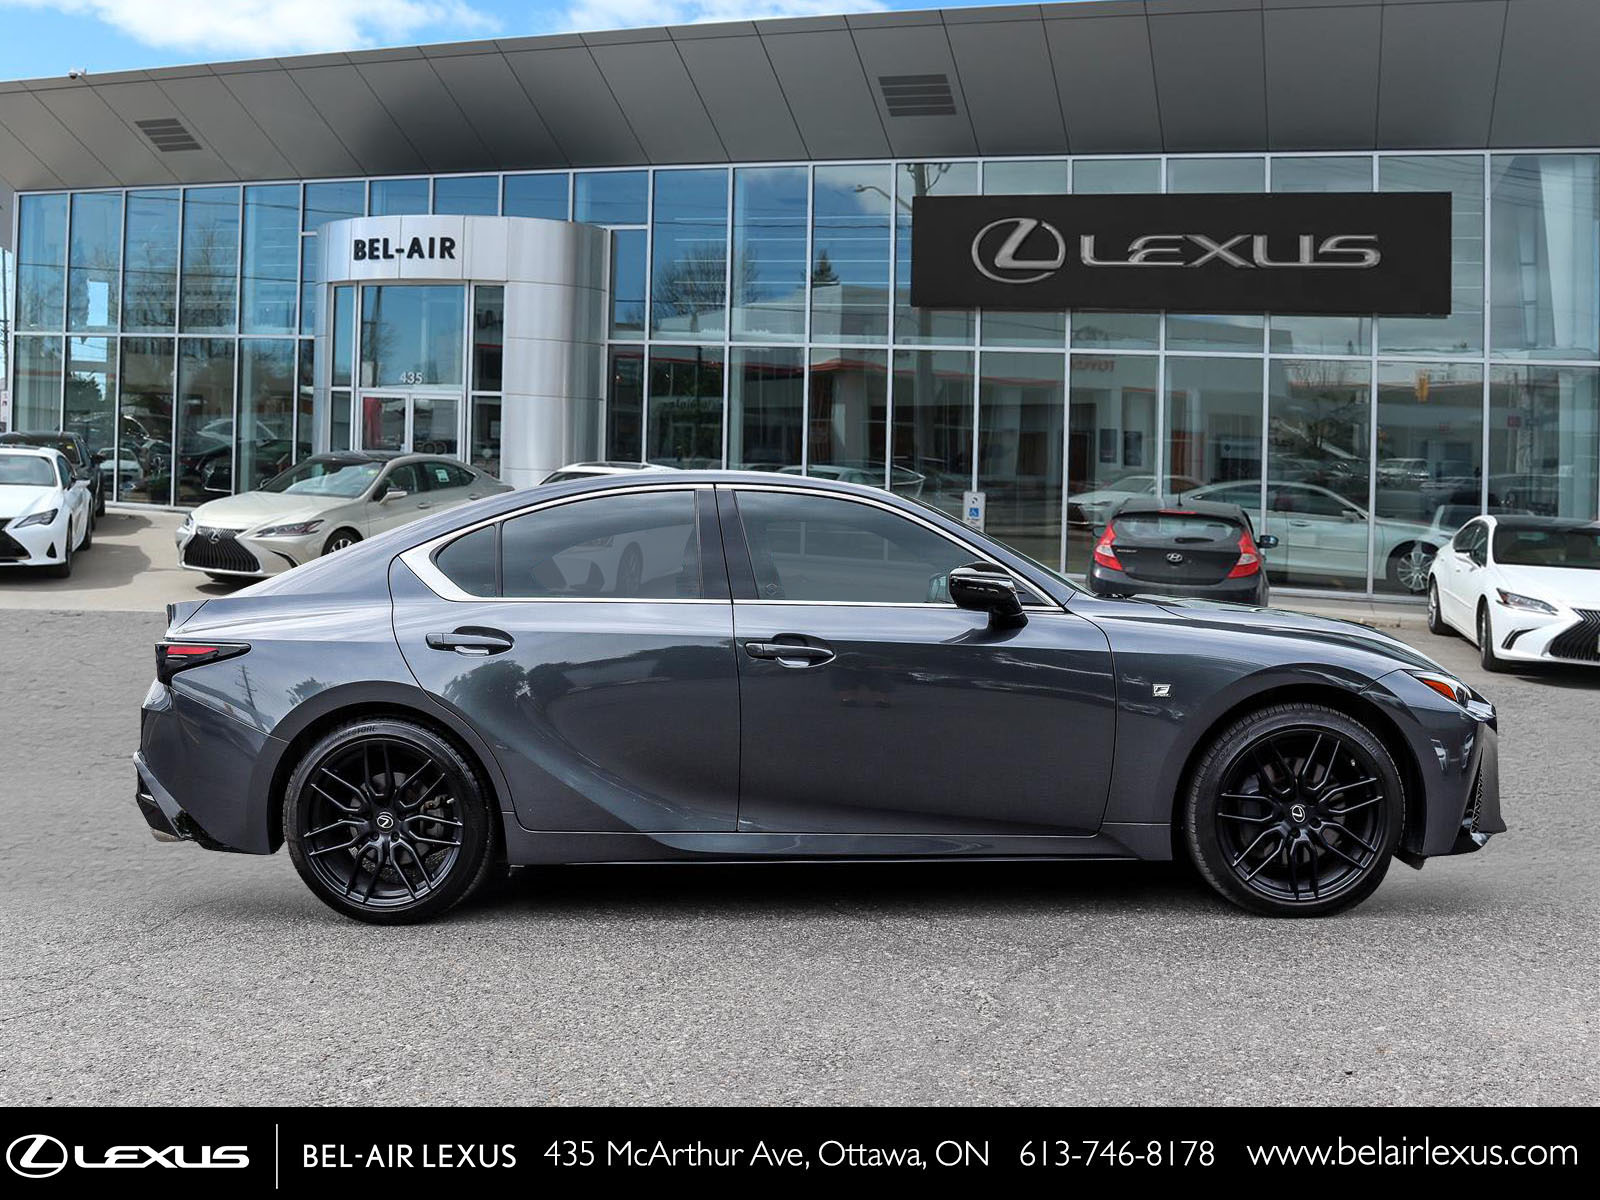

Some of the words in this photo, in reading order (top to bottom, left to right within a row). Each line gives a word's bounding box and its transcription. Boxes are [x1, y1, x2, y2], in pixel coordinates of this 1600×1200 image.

[353, 237, 456, 260] BEL-AIR
[1080, 234, 1381, 268] LEXUS
[400, 371, 423, 385] 435
